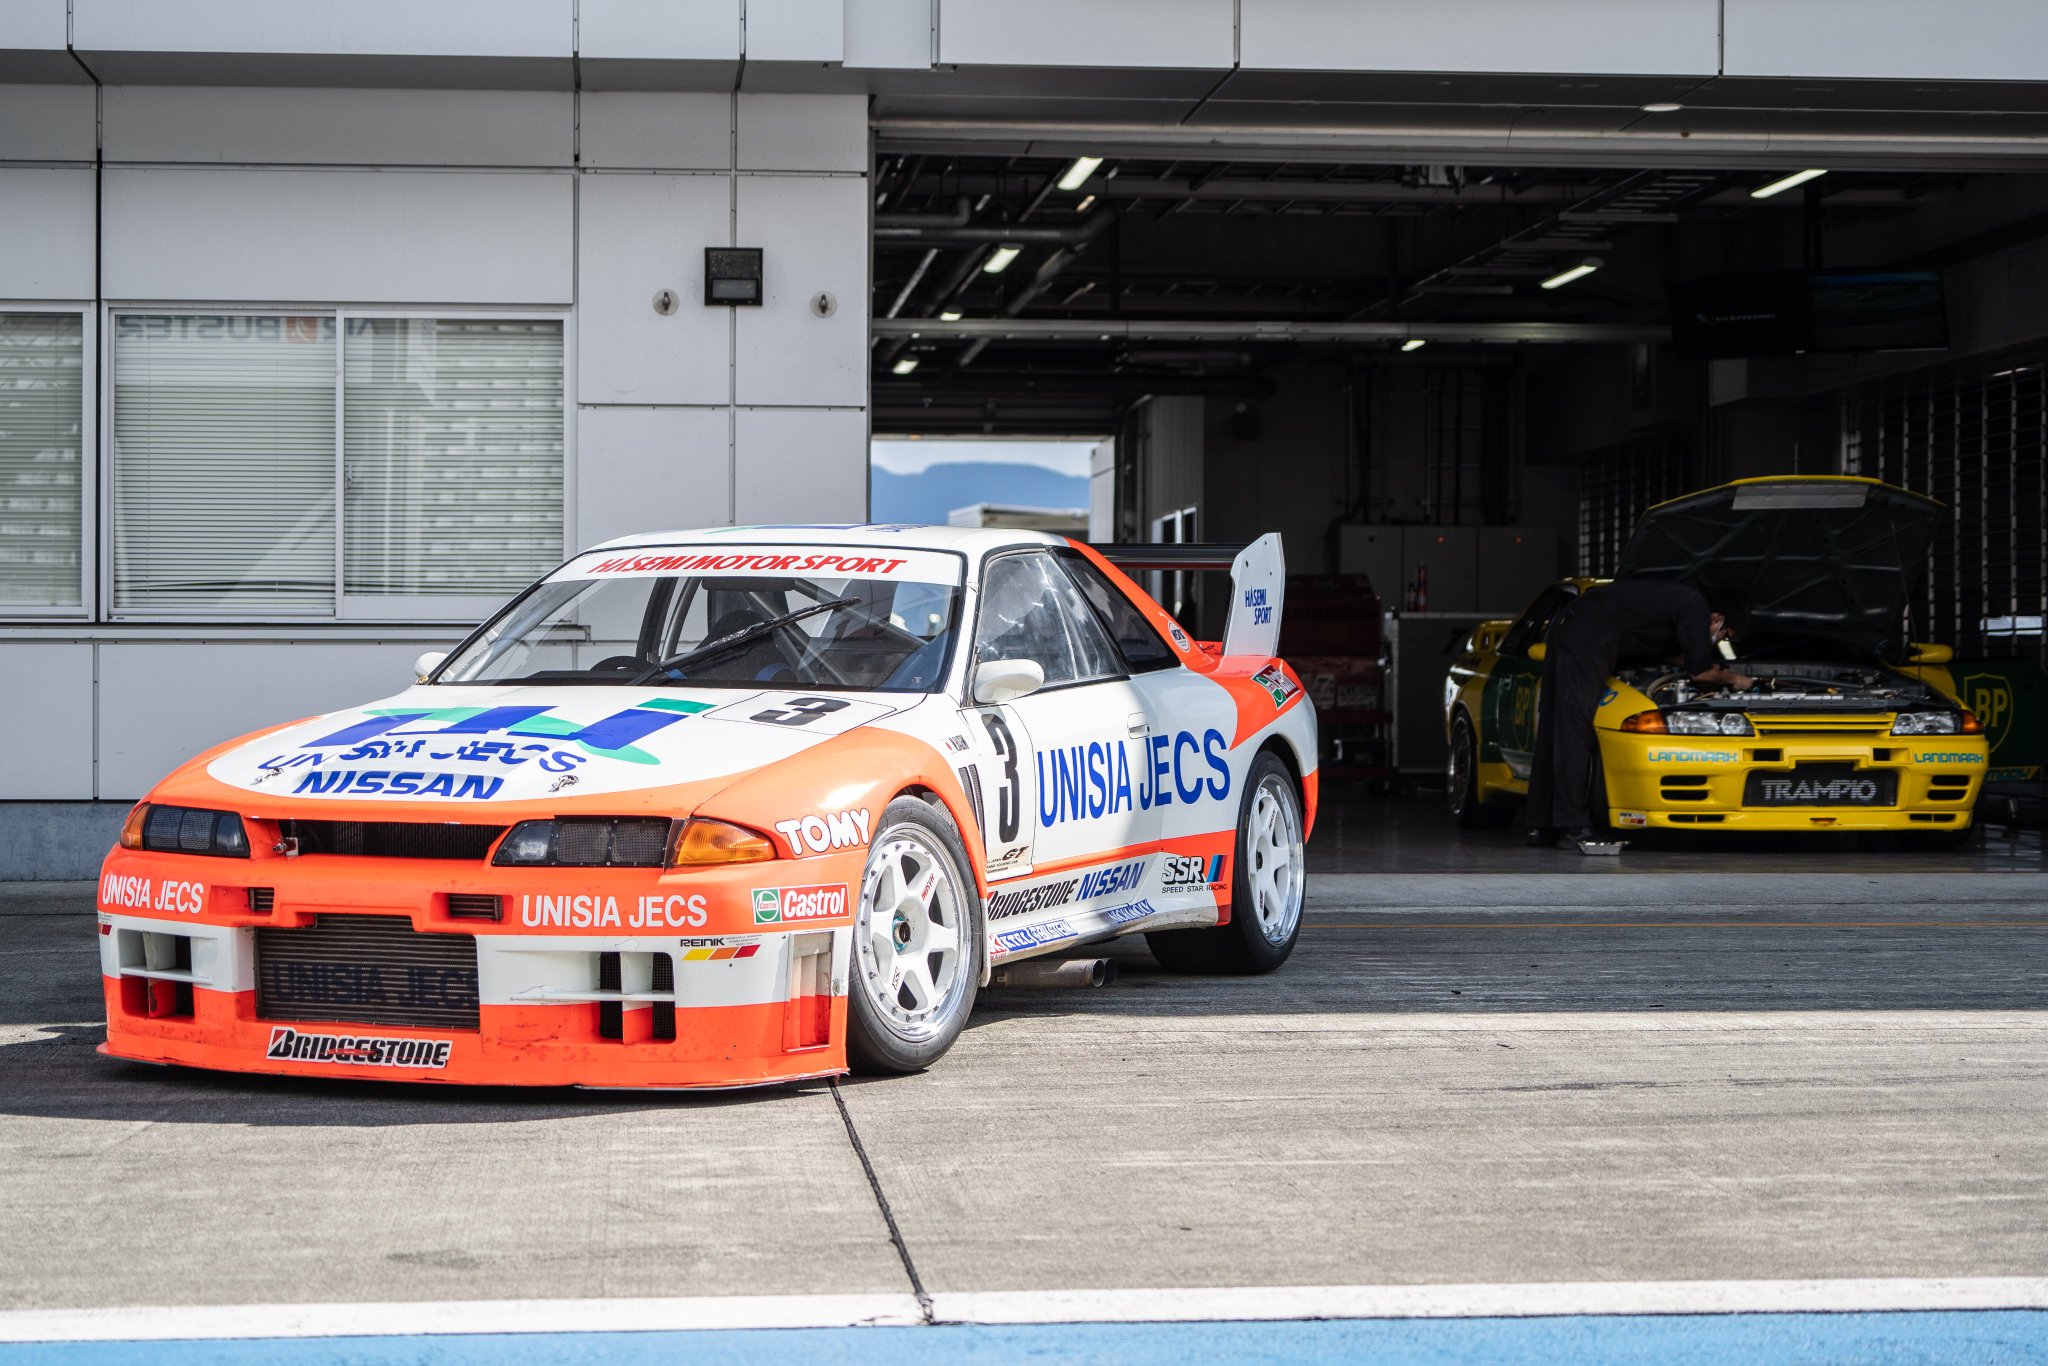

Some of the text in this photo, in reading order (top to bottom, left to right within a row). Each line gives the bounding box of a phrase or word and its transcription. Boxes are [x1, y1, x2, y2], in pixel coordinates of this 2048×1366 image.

[587, 554, 690, 574] HASEMI
[1244, 585, 1267, 607] HASEMI
[1254, 606, 1272, 625] SPORT
[748, 698, 852, 726] 3
[1975, 688, 2008, 728] BP
[258, 740, 427, 771] UNSIA
[1648, 751, 1738, 763] LANDMARK
[1914, 752, 1985, 764] LANDMARK
[292, 771, 504, 800] NISSAN
[981, 714, 1020, 844] 3
[1037, 729, 1231, 828] UNISIA JECS
[1761, 779, 1877, 800] TRAMPIO
[775, 808, 870, 857] TOMY
[1161, 856, 1205, 885] SSR
[102, 875, 204, 914] UNISIA JECS
[759, 901, 777, 910] Castrol
[784, 888, 846, 918] Castrol
[987, 861, 1145, 921] BRIDGESTONE NISSAN
[521, 893, 707, 928] UNISIA JECS
[680, 937, 725, 947] REINIK
[273, 960, 385, 1003] UNISIA
[270, 1027, 450, 1068] BRIDGESTONE
